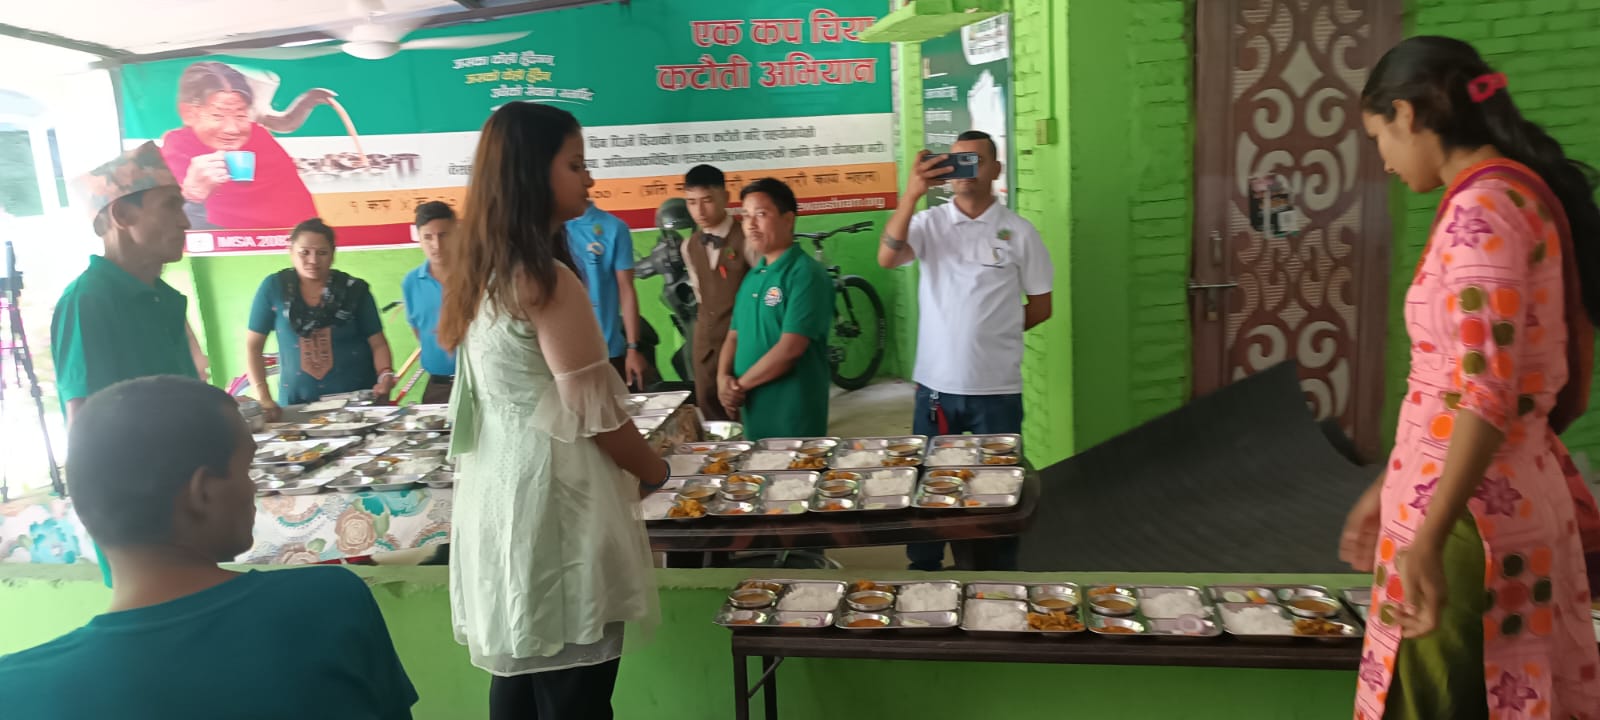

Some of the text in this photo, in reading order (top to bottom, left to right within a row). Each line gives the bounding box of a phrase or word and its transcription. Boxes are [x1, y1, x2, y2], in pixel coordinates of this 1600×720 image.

[691, 20, 745, 47] एक
[750, 18, 804, 44] कप
[655, 51, 878, 91] कटौती अभियान
